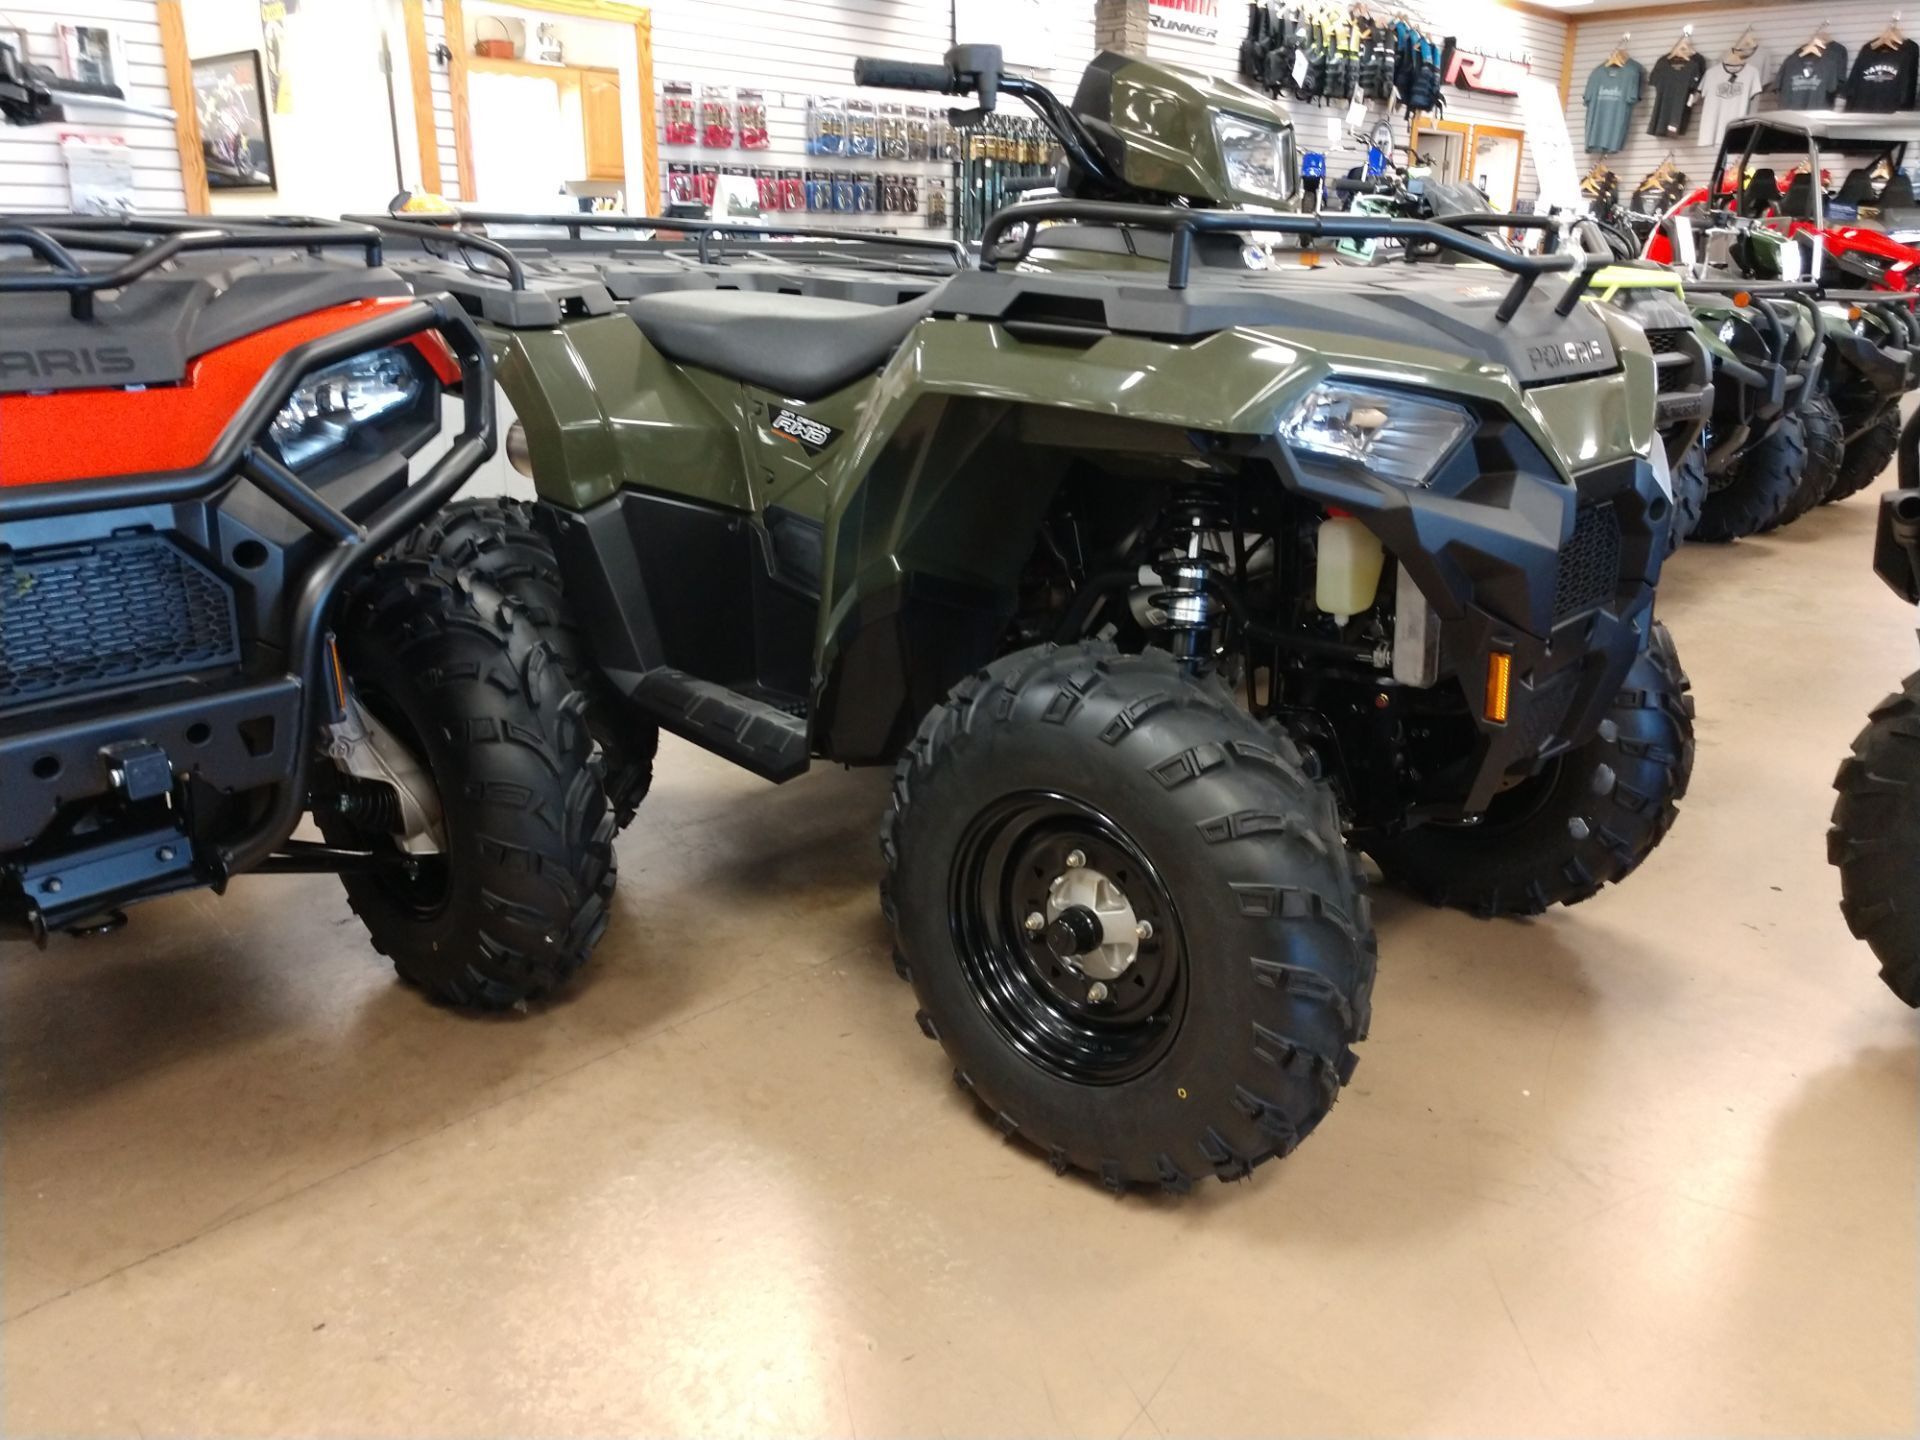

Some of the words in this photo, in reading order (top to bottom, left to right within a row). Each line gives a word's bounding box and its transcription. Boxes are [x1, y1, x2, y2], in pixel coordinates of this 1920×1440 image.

[0, 346, 136, 378] ARIS
[1526, 339, 1605, 372] POLARIS
[773, 415, 827, 445] AWD
